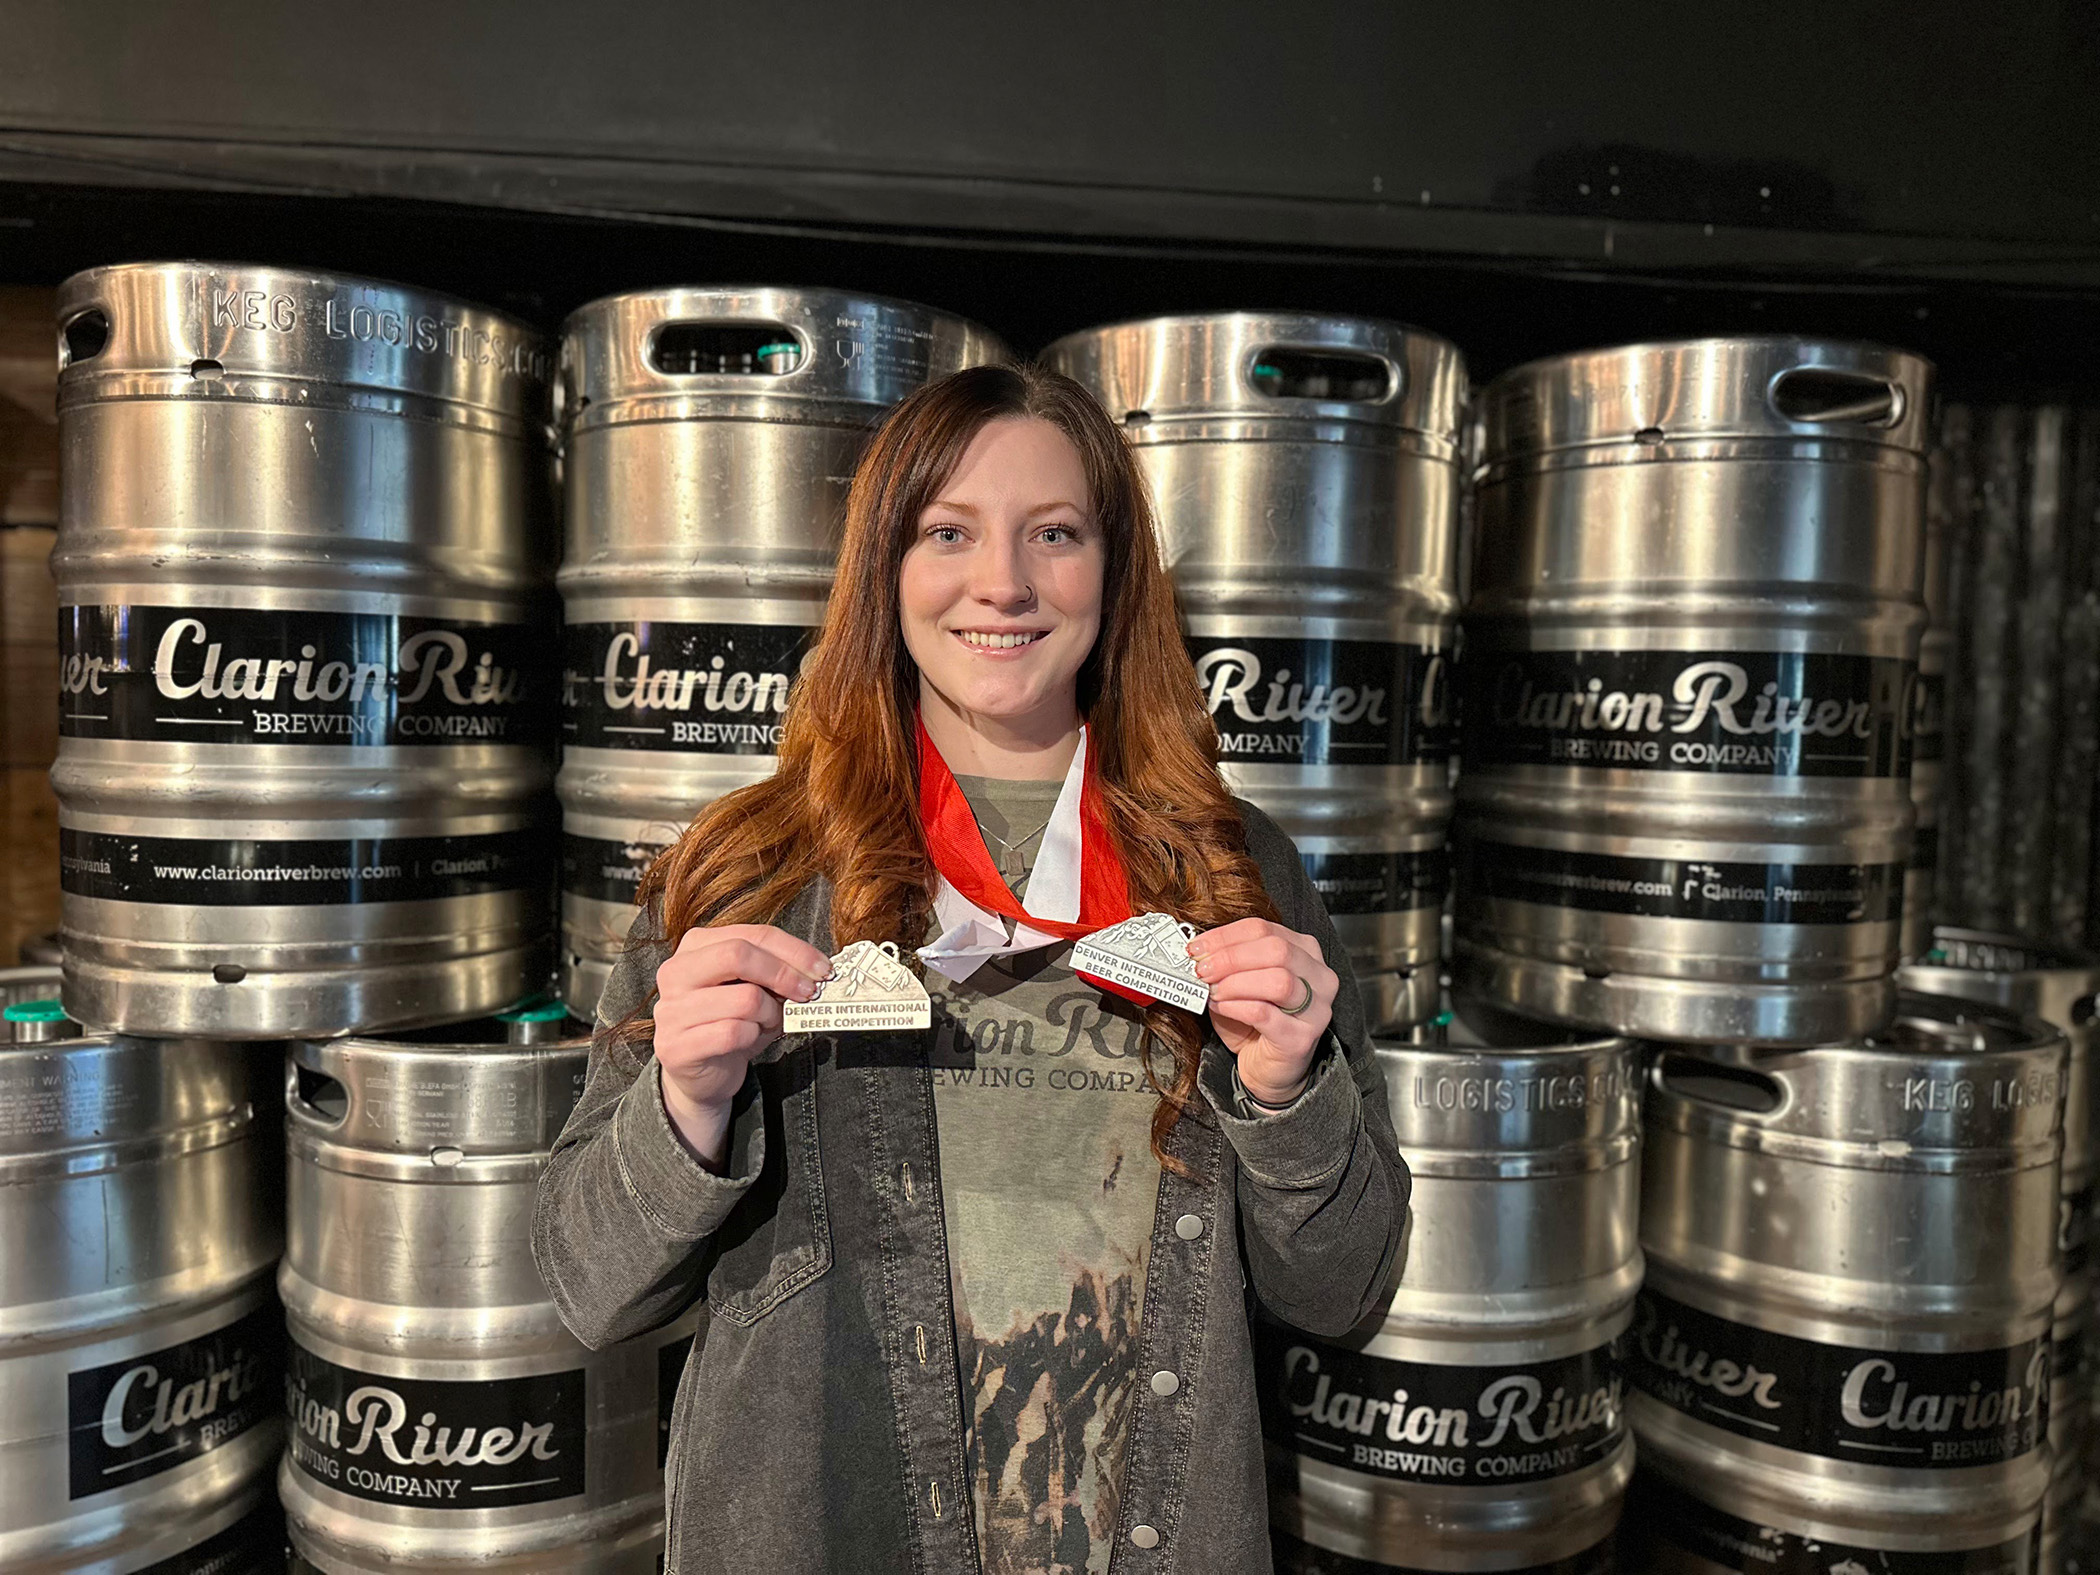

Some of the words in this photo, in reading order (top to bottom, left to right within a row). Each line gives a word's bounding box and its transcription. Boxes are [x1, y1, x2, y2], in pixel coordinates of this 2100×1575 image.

[214, 289, 296, 332] KEG
[154, 618, 389, 702] Clarion
[603, 631, 790, 713] Clarion
[1195, 647, 1388, 726] River
[1670, 660, 1872, 739] River
[399, 715, 508, 737] COMPANY
[671, 721, 787, 745] BREWING
[1216, 732, 1311, 754] MPANY
[1670, 742, 1799, 766] COMPANY
[153, 863, 402, 882] www.clarionriverbrew.com
[1075, 945, 1118, 969] DENVER
[1120, 962, 1206, 1000] INTERNATIONAL
[1085, 961, 1113, 975] BEER
[1115, 973, 1189, 1006] COMPETITION
[785, 1005, 833, 1016] DENVER
[835, 1003, 929, 1015] INTERNATIONAL
[800, 1018, 831, 1029] BEER
[834, 1016, 914, 1028] COMPETITION
[1283, 1346, 1469, 1448] Clarion
[1840, 1358, 2022, 1432] Clarion
[345, 1386, 560, 1467] River
[1352, 1443, 1467, 1478] BREWING
[1475, 1444, 1580, 1478] COMPANY
[346, 1467, 462, 1499] COMPANY
